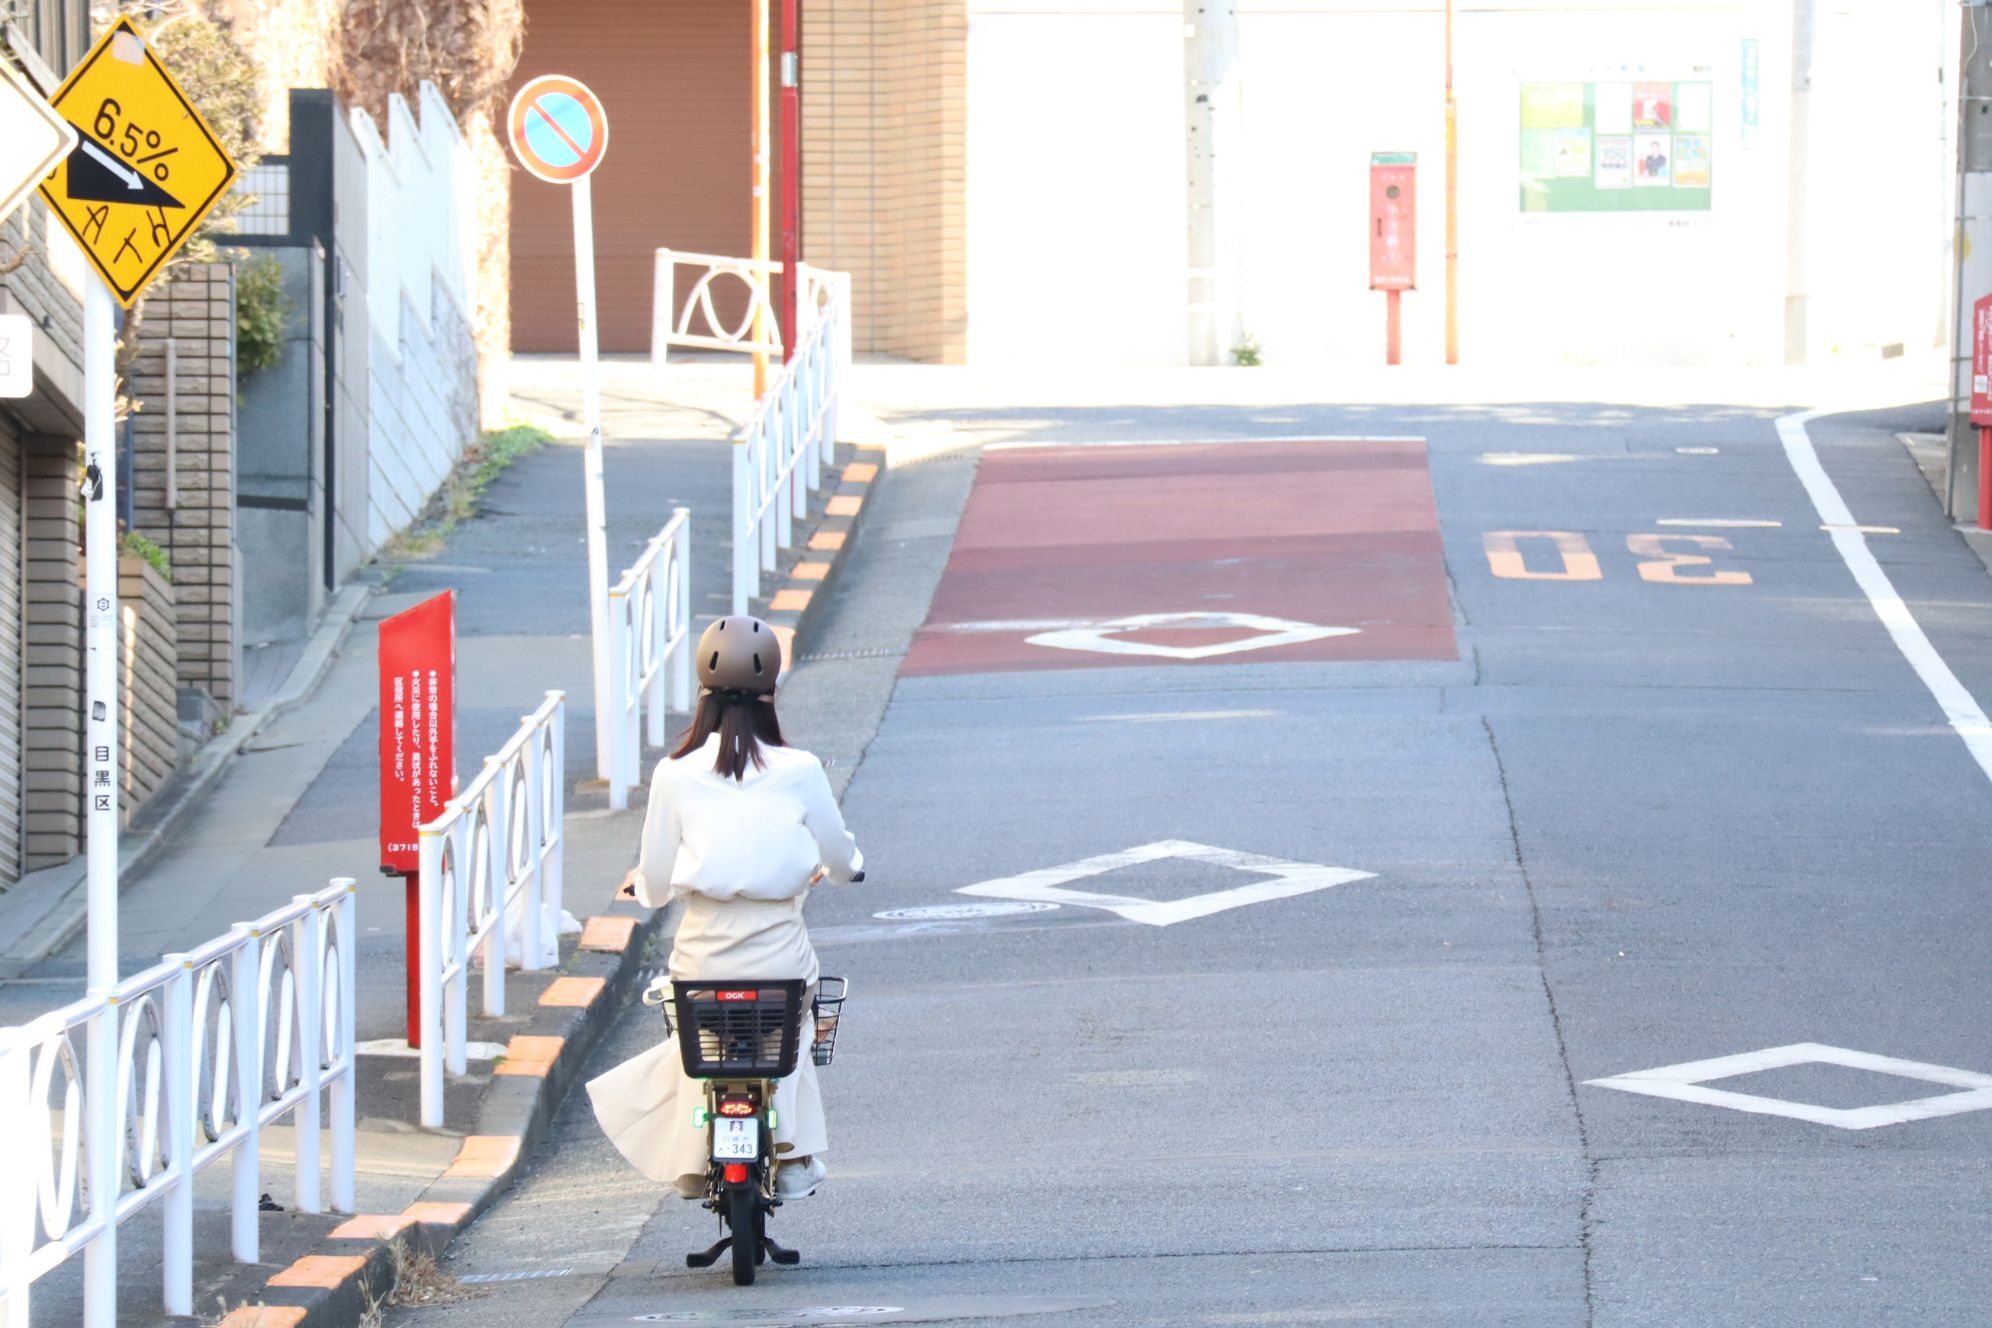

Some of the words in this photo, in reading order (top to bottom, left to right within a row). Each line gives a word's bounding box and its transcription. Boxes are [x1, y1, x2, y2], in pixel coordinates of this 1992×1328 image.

[93, 97, 179, 182] 6.5%
[94, 745, 111, 811] 目黒区
[725, 991, 745, 1000] OGK
